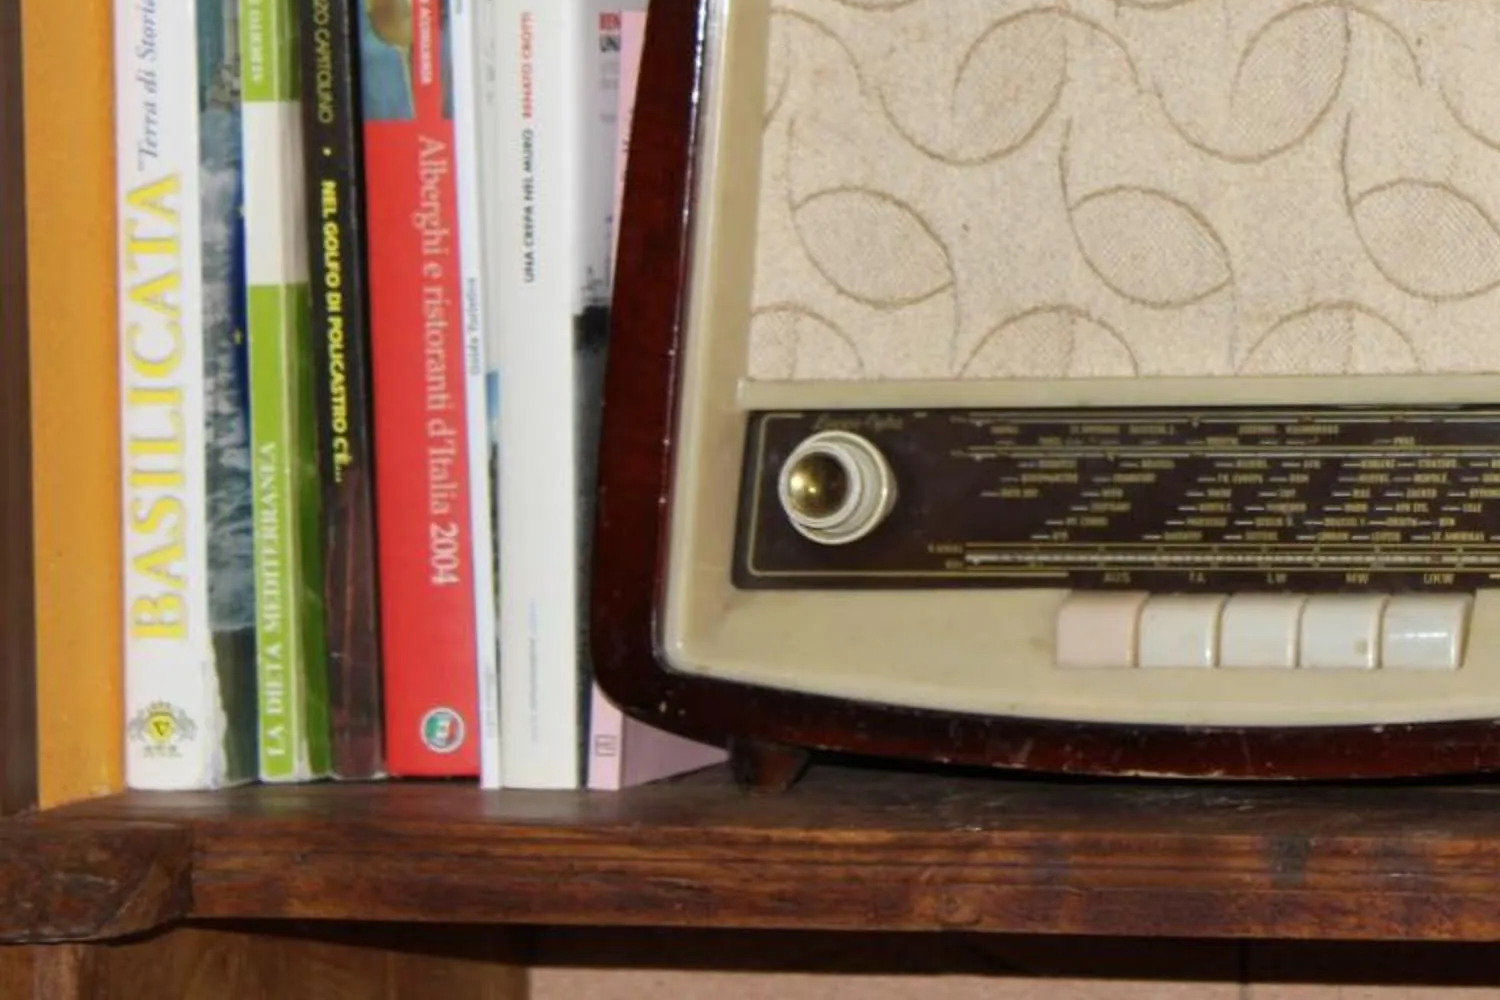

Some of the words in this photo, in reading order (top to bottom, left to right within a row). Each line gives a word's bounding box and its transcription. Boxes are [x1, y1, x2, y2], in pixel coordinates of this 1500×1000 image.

[135, 68, 157, 94] di
[320, 180, 338, 218] NEL
[410, 134, 449, 254] Alberghi
[522, 177, 535, 202] NEL
[322, 222, 342, 287] GOLFO
[422, 263, 442, 279] e
[325, 291, 343, 312] DI
[328, 316, 348, 433] POLICASTRO
[424, 286, 453, 410] ristoranti
[125, 172, 189, 640] BASILICATA
[258, 441, 284, 634] MEDITERRANEA
[430, 521, 459, 586] 2004
[261, 642, 286, 716] DIETA
[264, 725, 287, 757] LA
